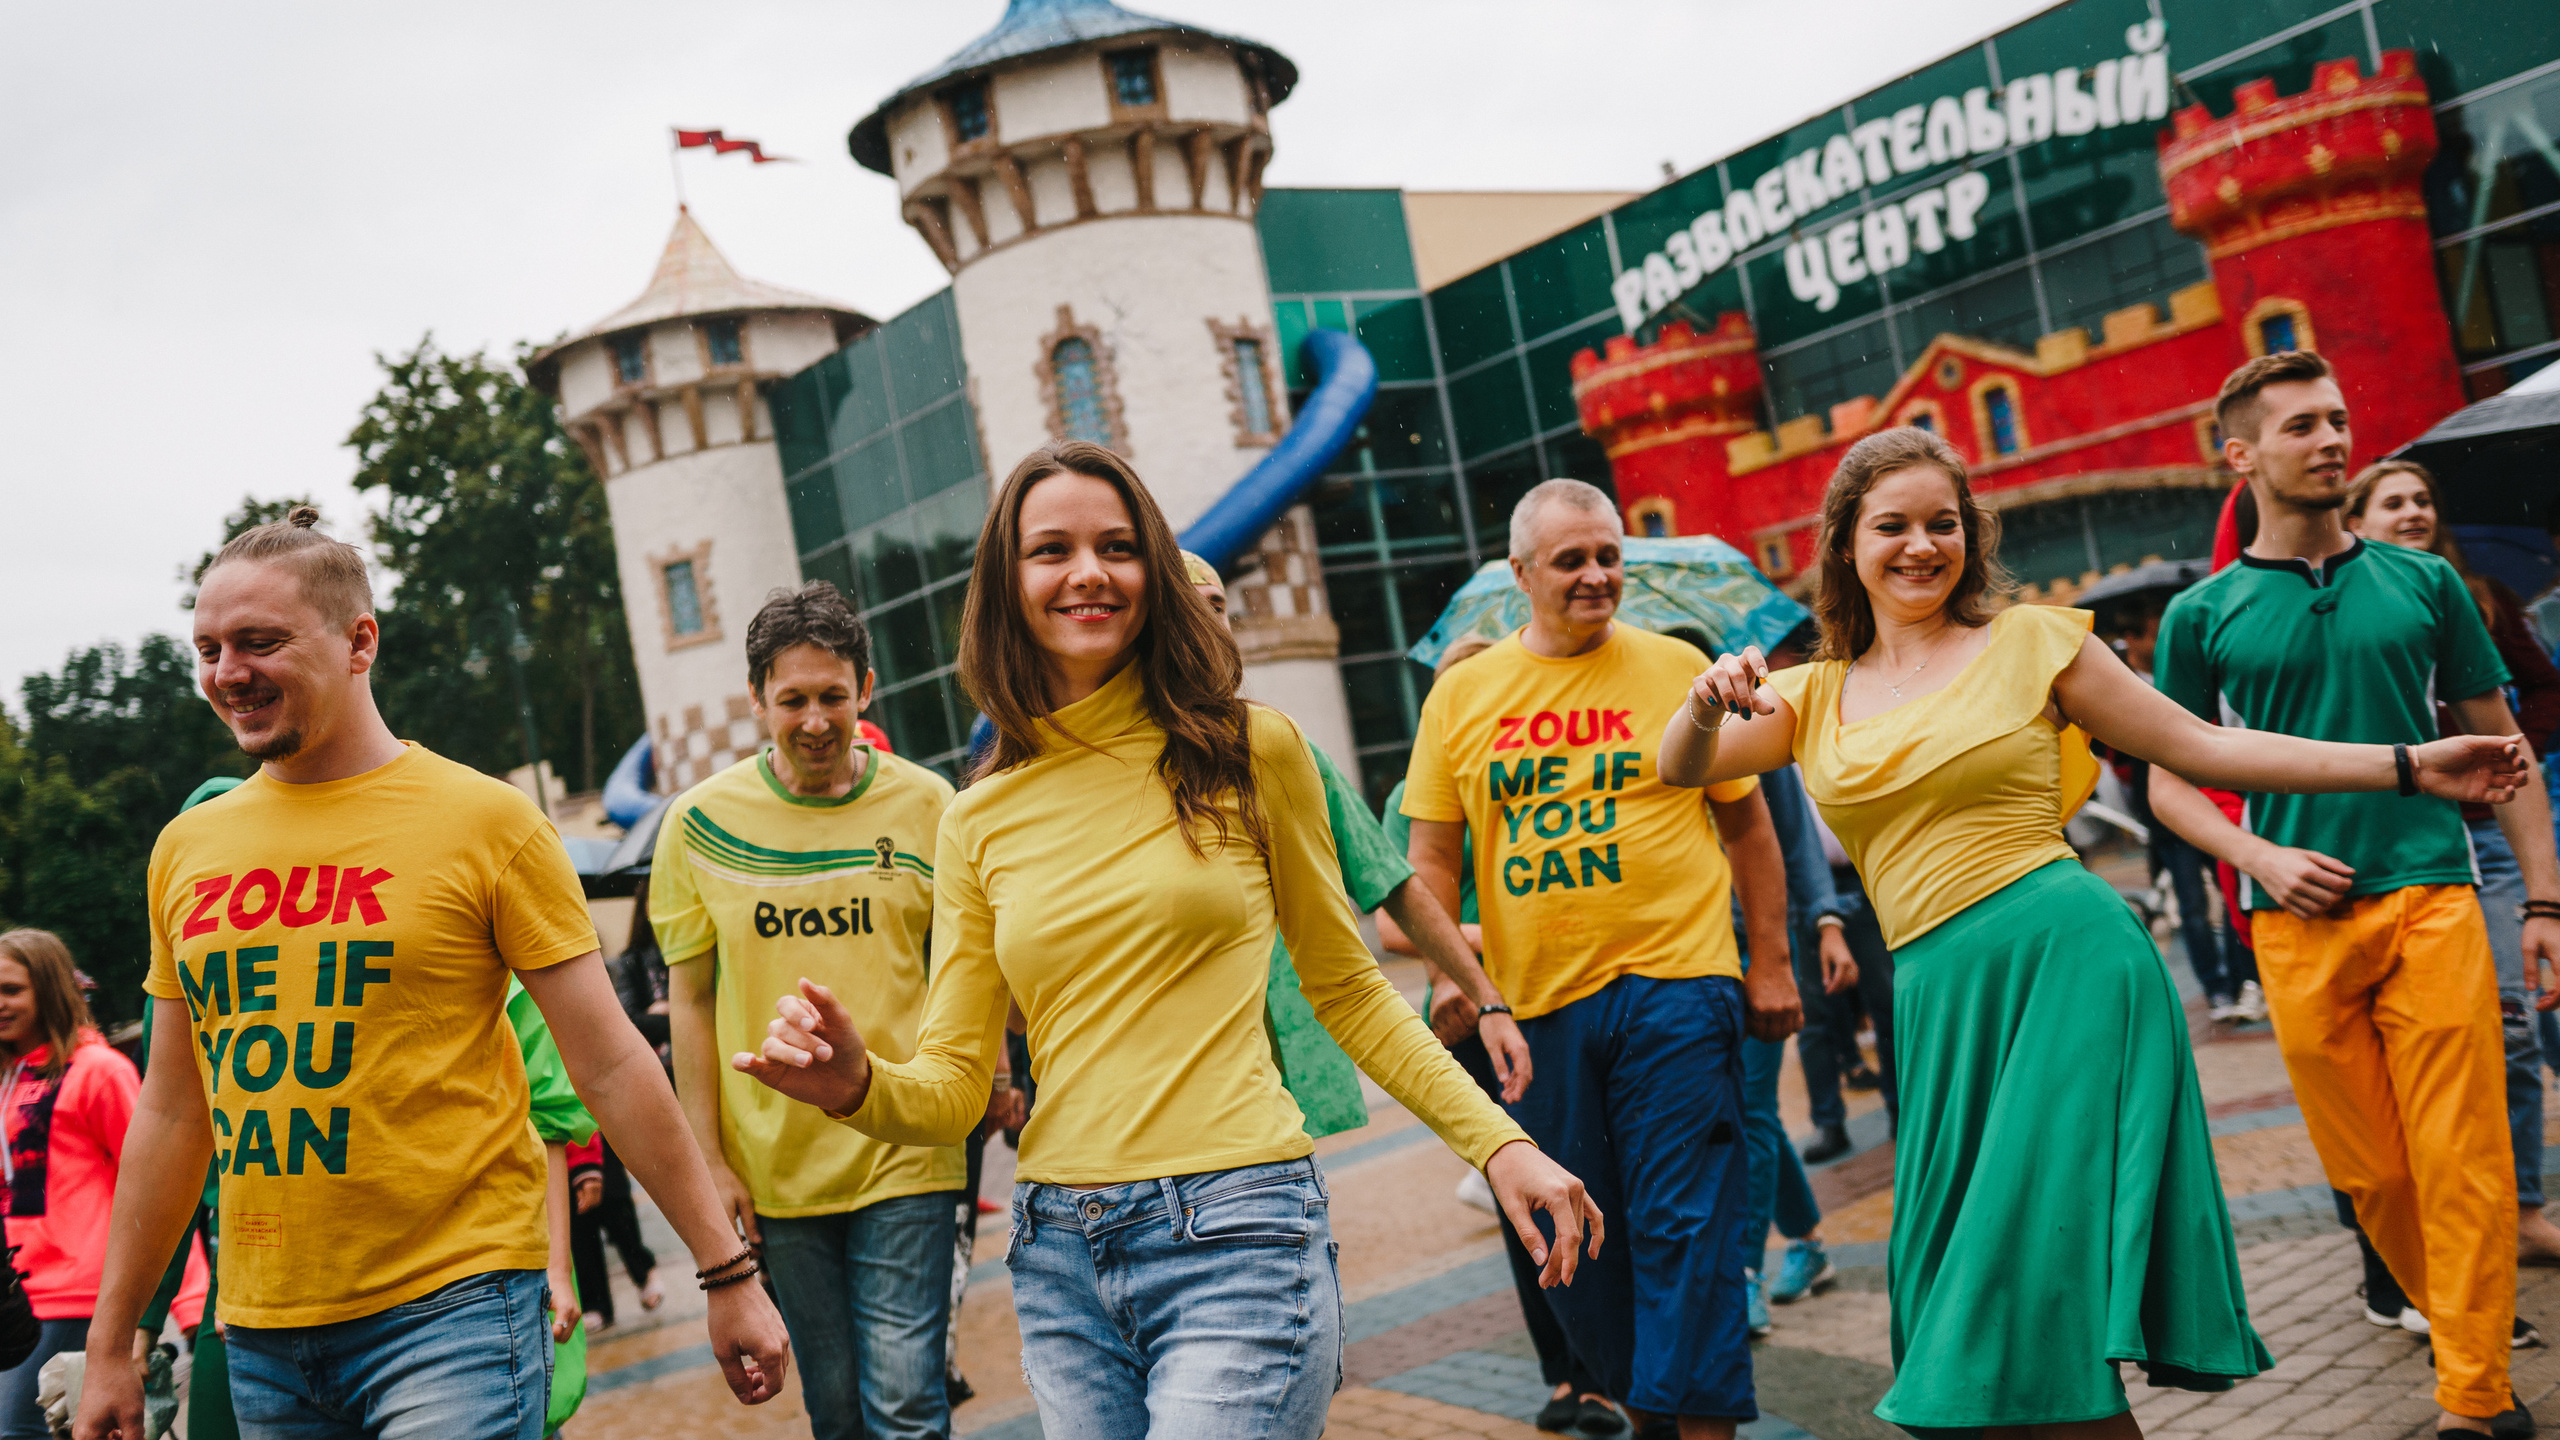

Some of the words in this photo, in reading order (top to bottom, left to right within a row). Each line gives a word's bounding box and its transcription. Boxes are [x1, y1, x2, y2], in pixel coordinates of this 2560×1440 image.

[1611, 18, 2170, 335] РАЗВЛЕКАТЕЛЬНЫЙ
[1784, 171, 1990, 313] ЦЕНТР
[1493, 708, 1635, 752] ZOUK
[1489, 756, 1568, 801] ME
[1592, 751, 1641, 791] IF
[1503, 797, 1616, 843] YOU
[182, 865, 395, 942] ZOUK
[1503, 843, 1622, 897] CAN
[754, 897, 873, 938] Brasil
[178, 945, 279, 1022] ME
[314, 941, 394, 1007] IF
[200, 1021, 355, 1094] YOU
[212, 1107, 350, 1176] CAN
